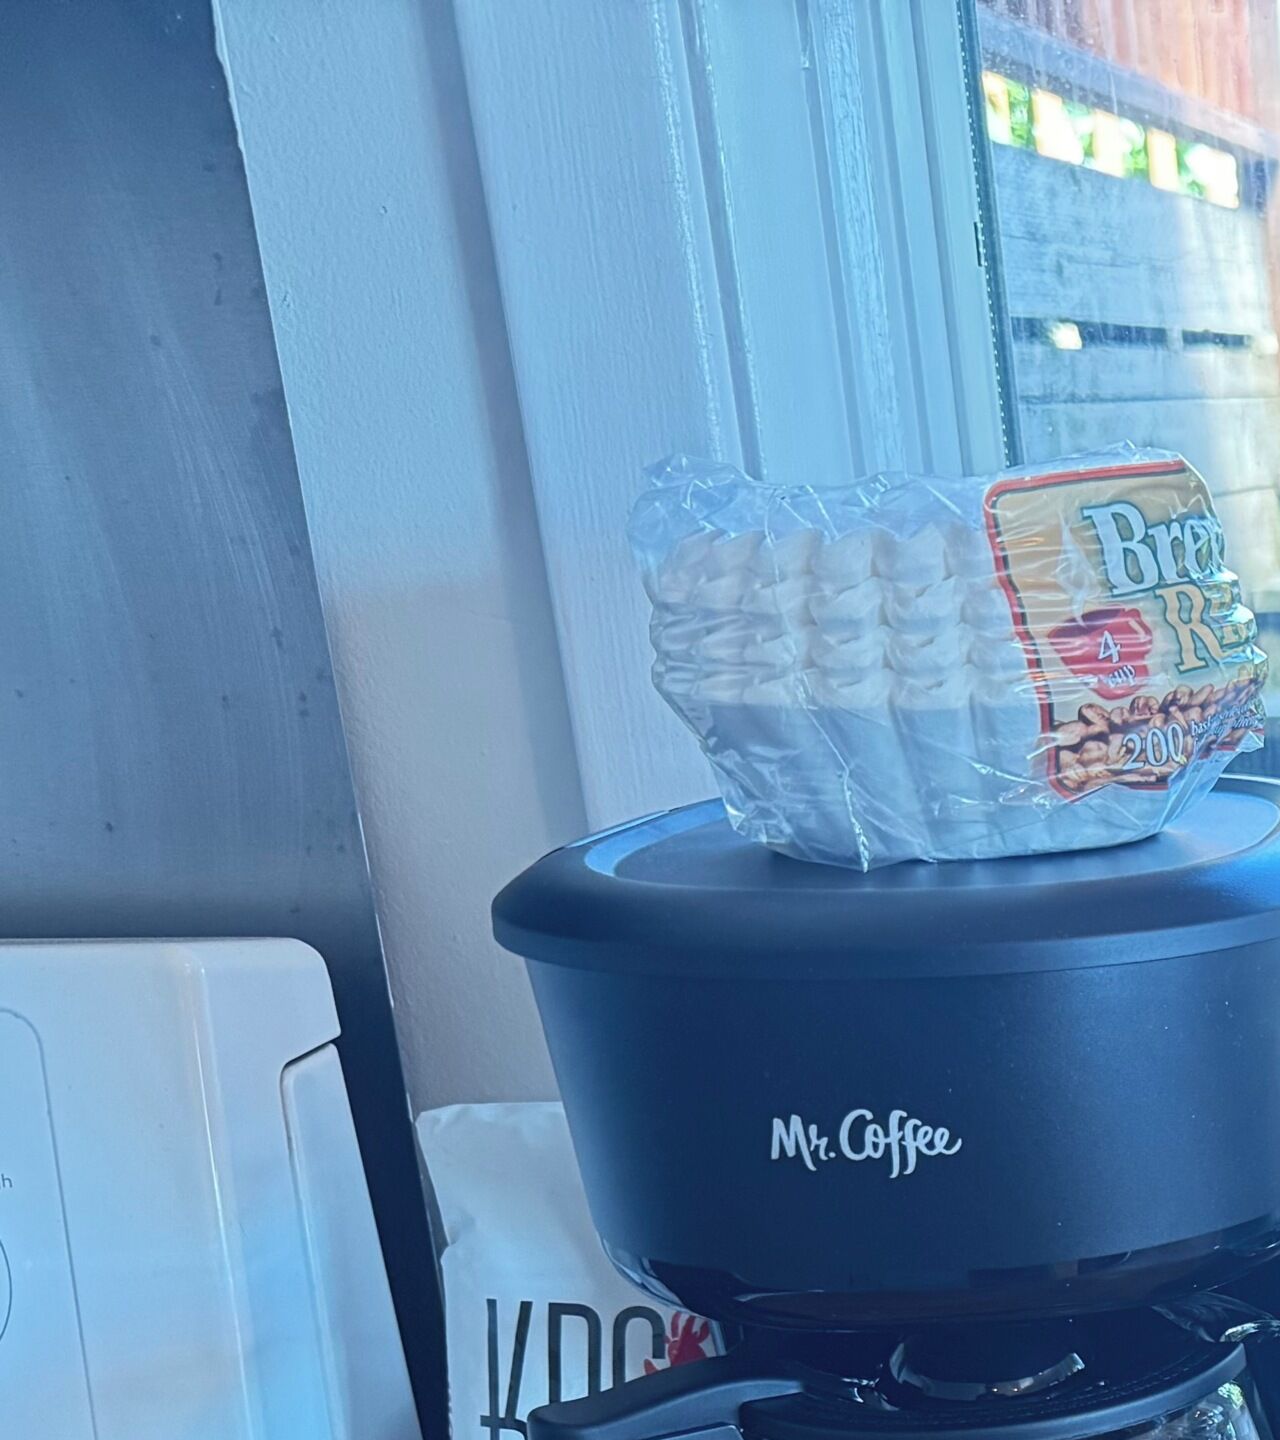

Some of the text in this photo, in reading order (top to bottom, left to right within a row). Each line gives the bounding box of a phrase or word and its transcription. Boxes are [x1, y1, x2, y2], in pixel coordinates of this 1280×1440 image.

[1098, 630, 1120, 664] 4
[1122, 722, 1186, 770] 200
[770, 1108, 963, 1179] Mr. Coffee
